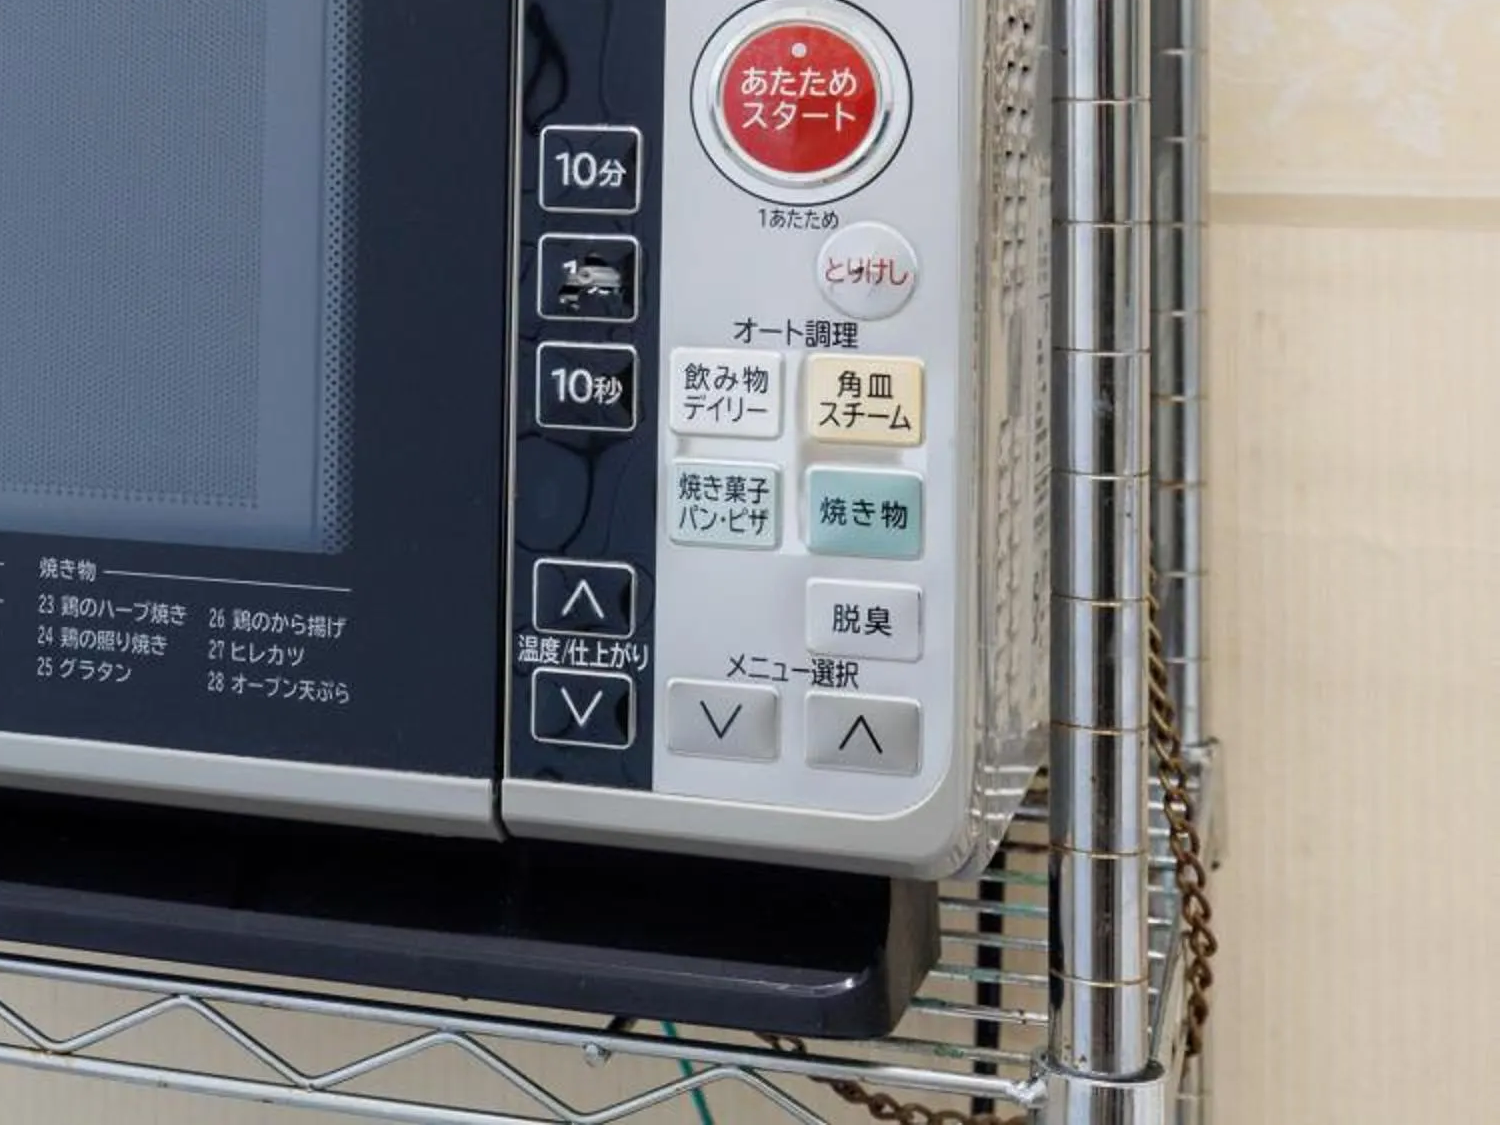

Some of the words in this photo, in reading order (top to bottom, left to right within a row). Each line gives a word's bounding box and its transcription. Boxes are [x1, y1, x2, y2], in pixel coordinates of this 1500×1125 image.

[741, 66, 858, 97] あたため
[742, 101, 856, 132] スタート
[555, 152, 626, 188] 10分
[825, 258, 909, 286] とりけし
[733, 318, 859, 349] オート調理
[551, 368, 623, 405] 10秒
[684, 362, 769, 394] 飲み物
[837, 370, 893, 400] 角皿
[684, 395, 767, 422] デイリー
[819, 401, 912, 430] スチーム
[679, 472, 769, 504] 焼き菓子
[820, 496, 908, 530] 焼き物
[39, 557, 96, 582] 焼き物
[38, 594, 54, 614] 23
[61, 595, 187, 626] 鶏のハーブ焼き
[209, 608, 225, 628] 26
[233, 609, 346, 639] 鶏のから揚げ
[833, 604, 892, 636] 脱臭
[38, 627, 53, 644] 24
[60, 628, 168, 656] 鶏の照り焼き
[208, 641, 225, 659] 27
[231, 643, 304, 667] ヒレカツ
[518, 635, 648, 671] 温度/仕上がり
[37, 658, 52, 676] 25
[60, 659, 131, 682] グラタン
[727, 654, 860, 689] メニュー選択
[208, 671, 224, 692] 28
[231, 674, 350, 704] オーブン天ぷら
